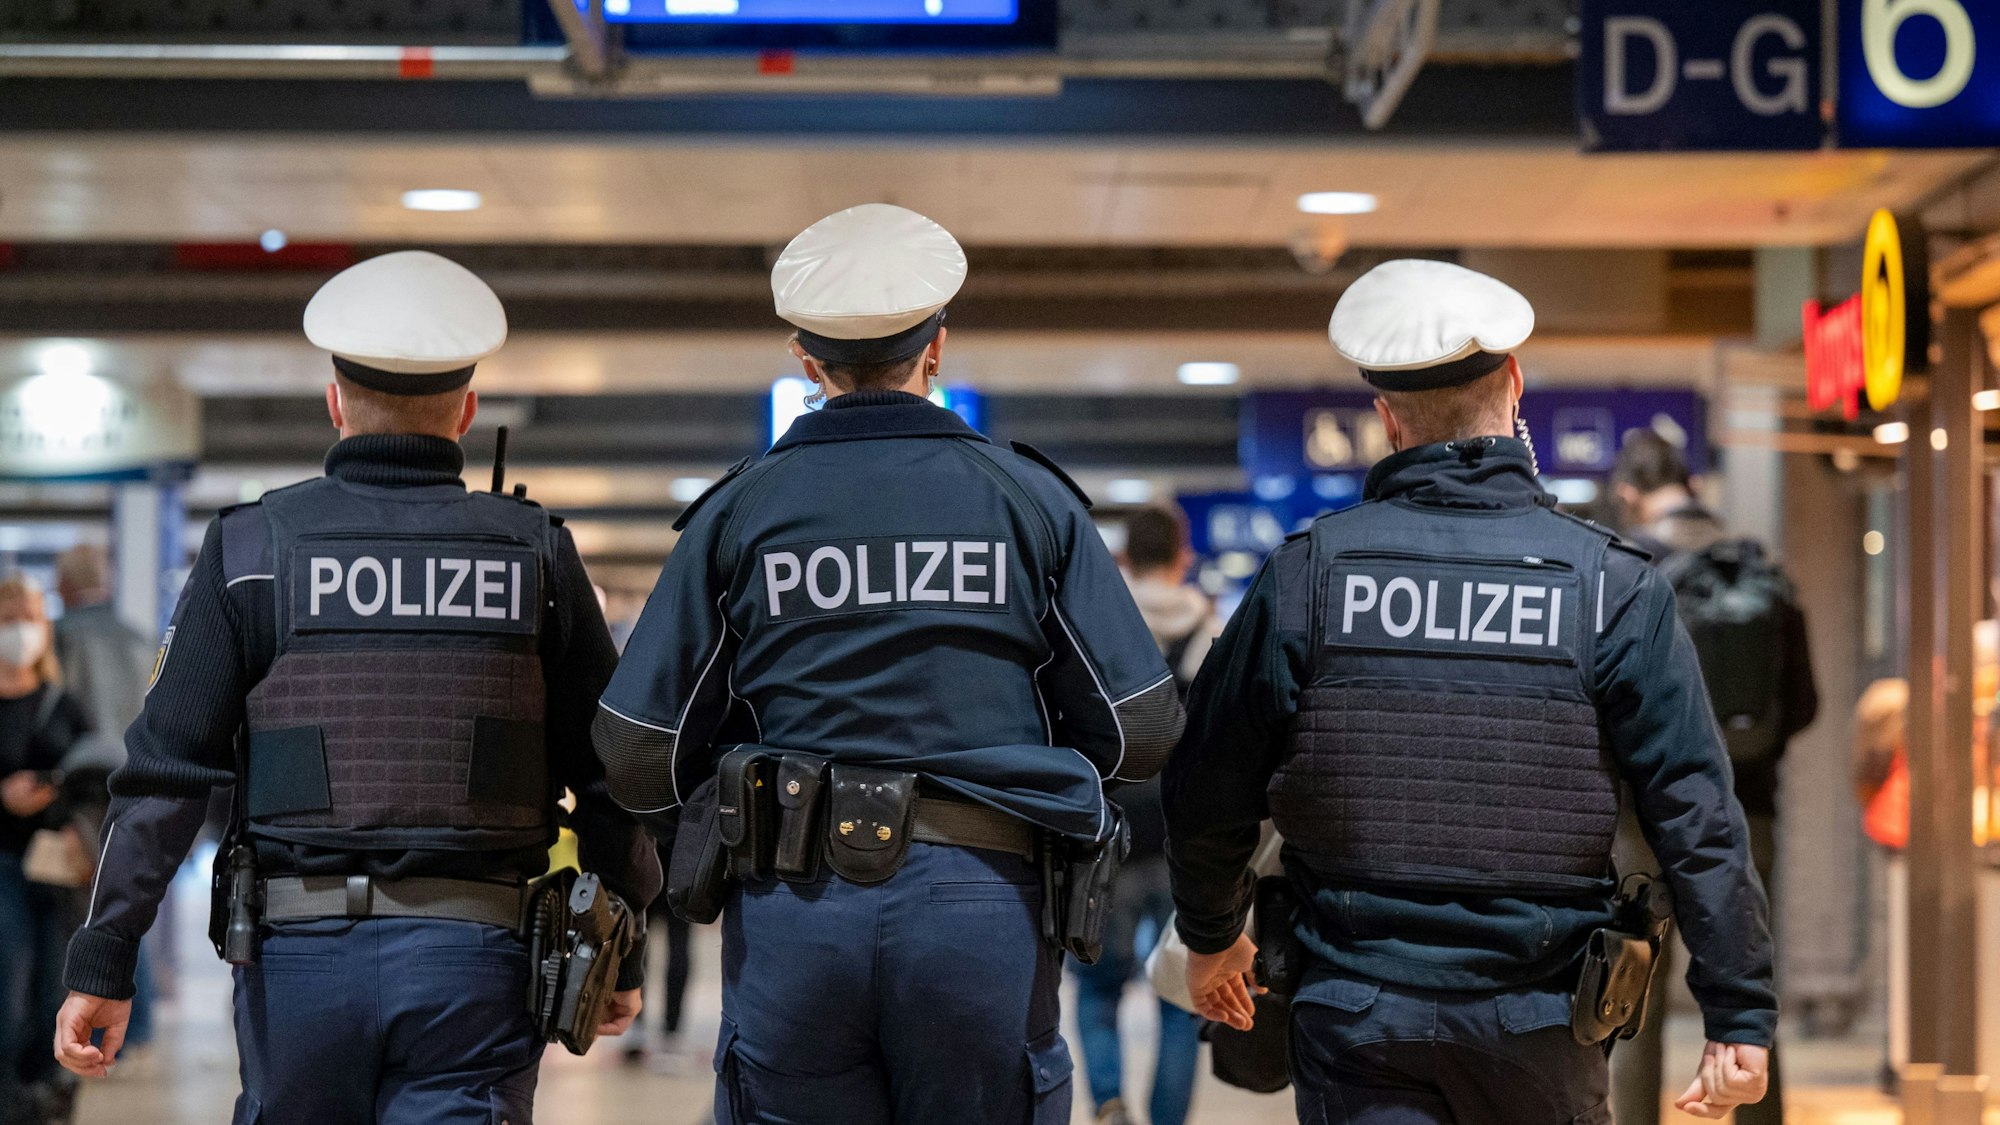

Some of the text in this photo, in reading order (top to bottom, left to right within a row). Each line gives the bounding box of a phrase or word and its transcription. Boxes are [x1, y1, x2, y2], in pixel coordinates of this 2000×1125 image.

[1603, 16, 1808, 114] D-G
[1862, 0, 1975, 108] 6
[311, 556, 521, 620] POLIZEI
[764, 541, 1007, 617] POLIZEI
[1342, 574, 1563, 647] POLIZEI
